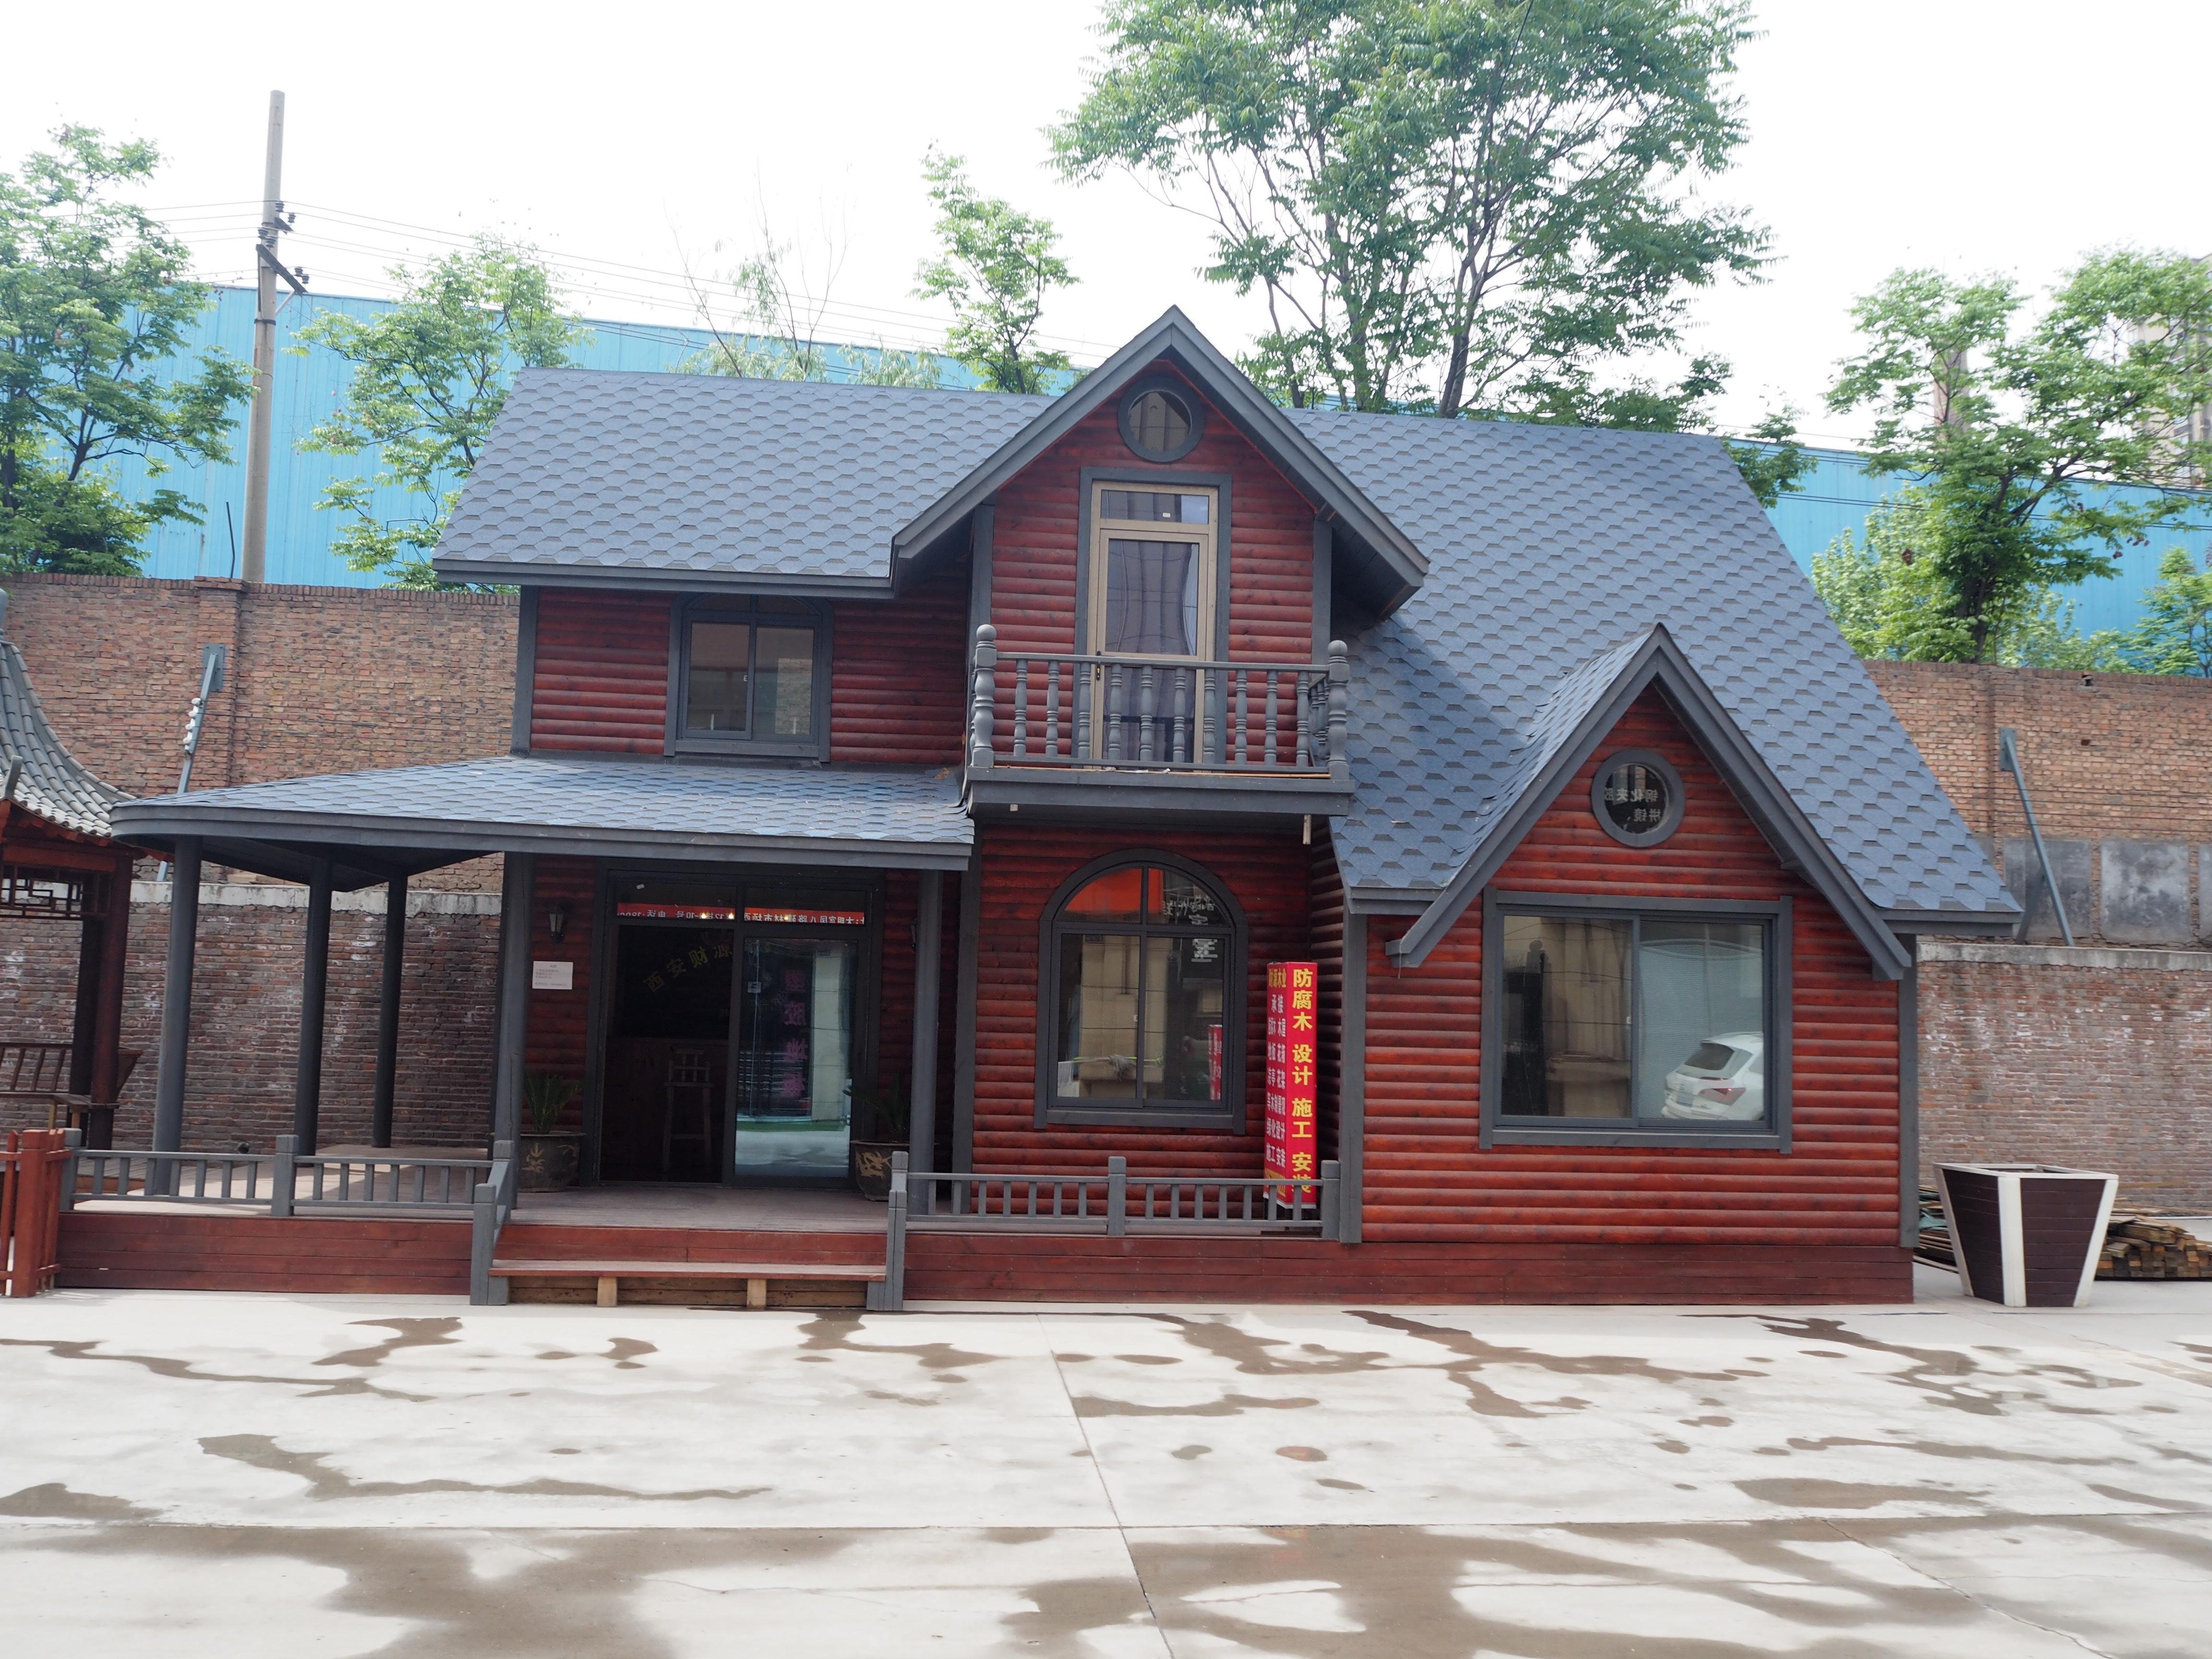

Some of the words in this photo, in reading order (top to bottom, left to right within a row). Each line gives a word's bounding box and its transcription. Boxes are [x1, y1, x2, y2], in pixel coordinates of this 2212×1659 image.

[1292, 968, 1313, 1032] 防腐木
[1292, 1044, 1313, 1085] 设计
[1291, 1098, 1313, 1138] 施工
